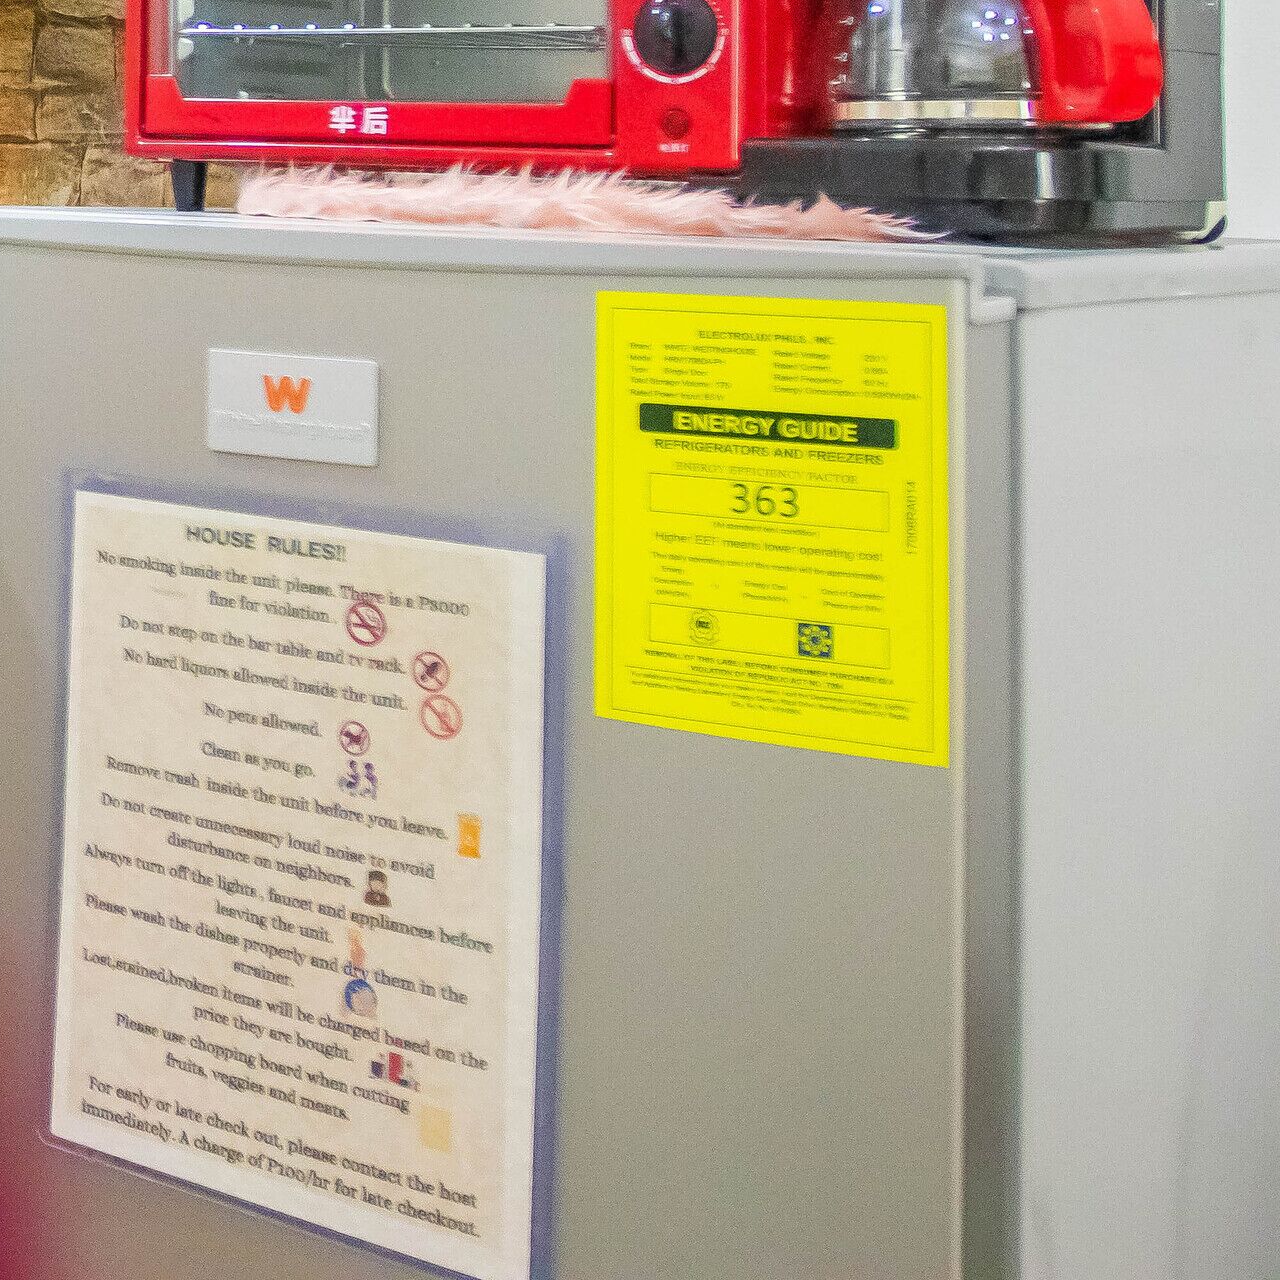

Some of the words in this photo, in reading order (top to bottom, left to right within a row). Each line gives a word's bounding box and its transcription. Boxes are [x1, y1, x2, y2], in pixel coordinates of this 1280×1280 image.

[262, 374, 313, 415] W
[671, 410, 778, 437] ENERGY
[776, 418, 861, 443] GUIDE
[653, 438, 771, 457] REFRIGERATORS
[772, 447, 805, 459] AND
[807, 449, 886, 466] FREEZERS
[674, 461, 725, 474] ENERGY
[728, 465, 803, 480] EFFICIENCY
[807, 472, 859, 484] FACTOR
[729, 481, 802, 519] 363
[186, 524, 256, 550] HOUSE
[654, 531, 691, 544] Higher
[764, 542, 796, 553] lower
[799, 545, 855, 561] operating
